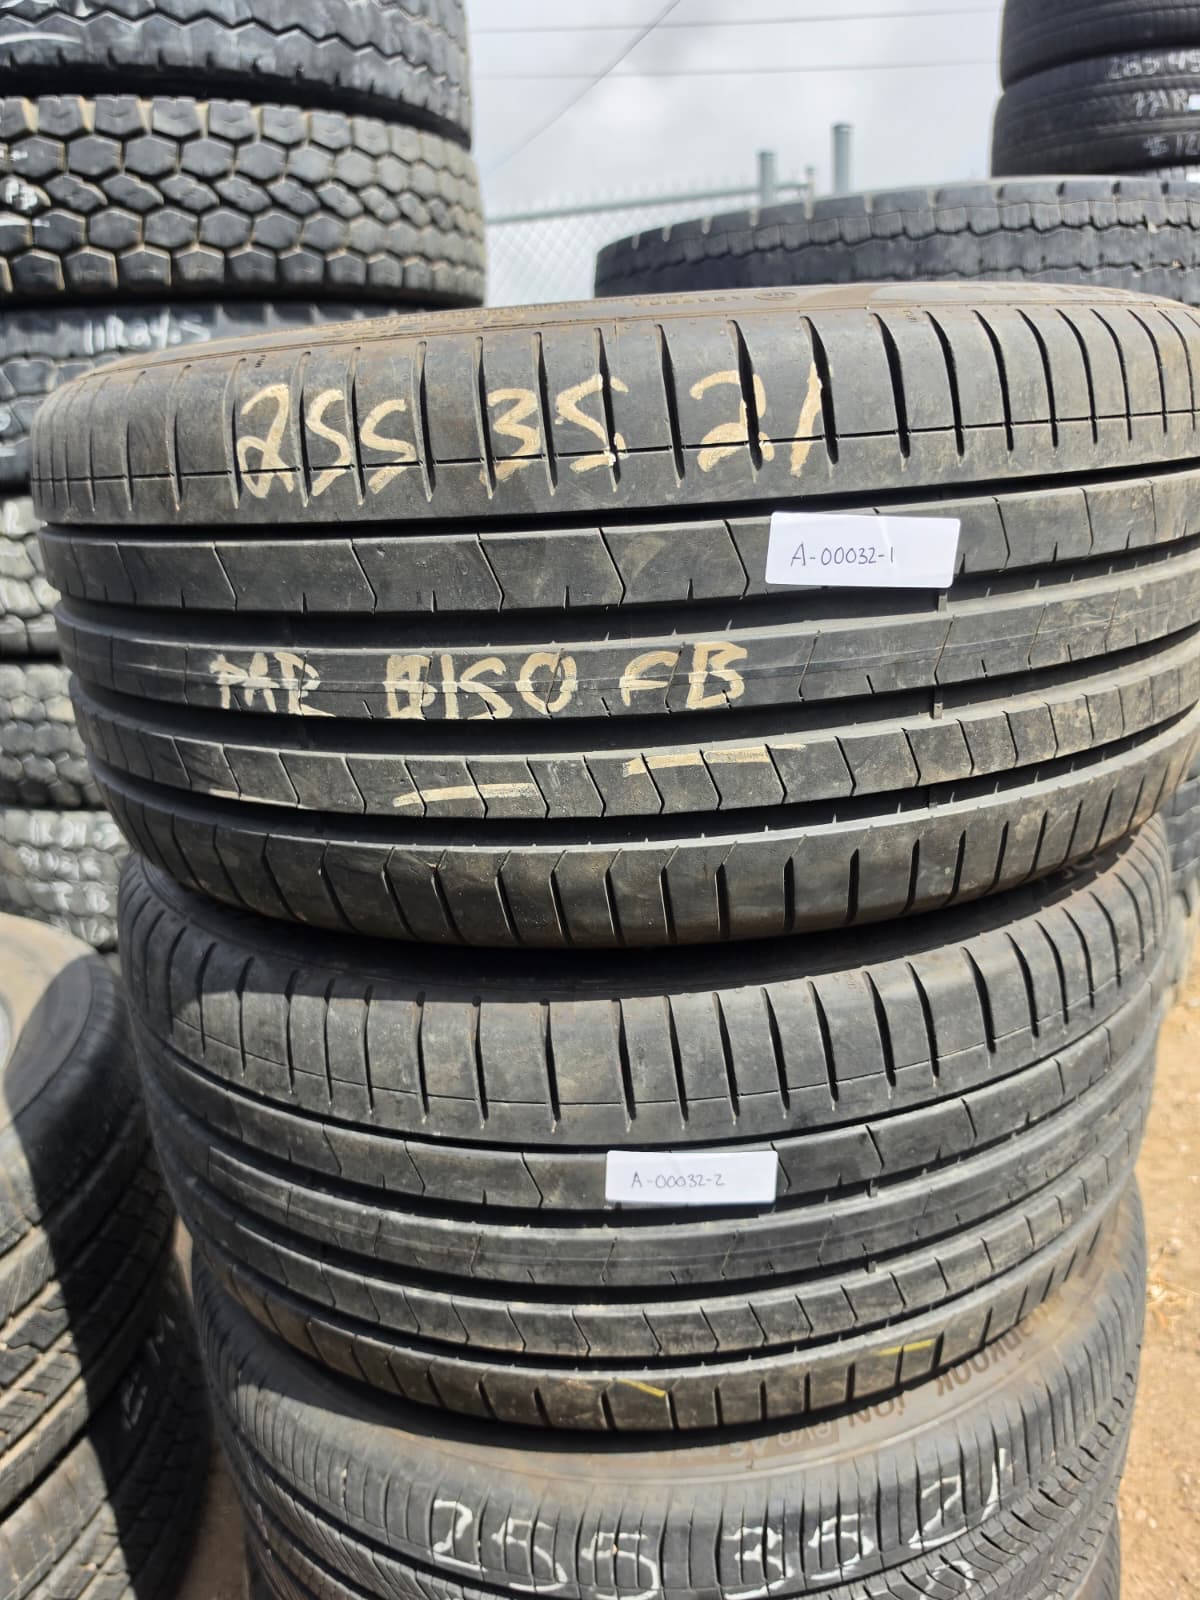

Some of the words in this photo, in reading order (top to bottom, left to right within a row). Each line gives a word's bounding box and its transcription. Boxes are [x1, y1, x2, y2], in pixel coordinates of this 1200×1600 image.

[236, 383, 417, 498] 255
[486, 373, 629, 484] 35
[790, 541, 894, 567] A-00032-1
[630, 1170, 726, 1189] A-00032-2
[427, 1498, 660, 1600] 255
[723, 1512, 874, 1600] 35
